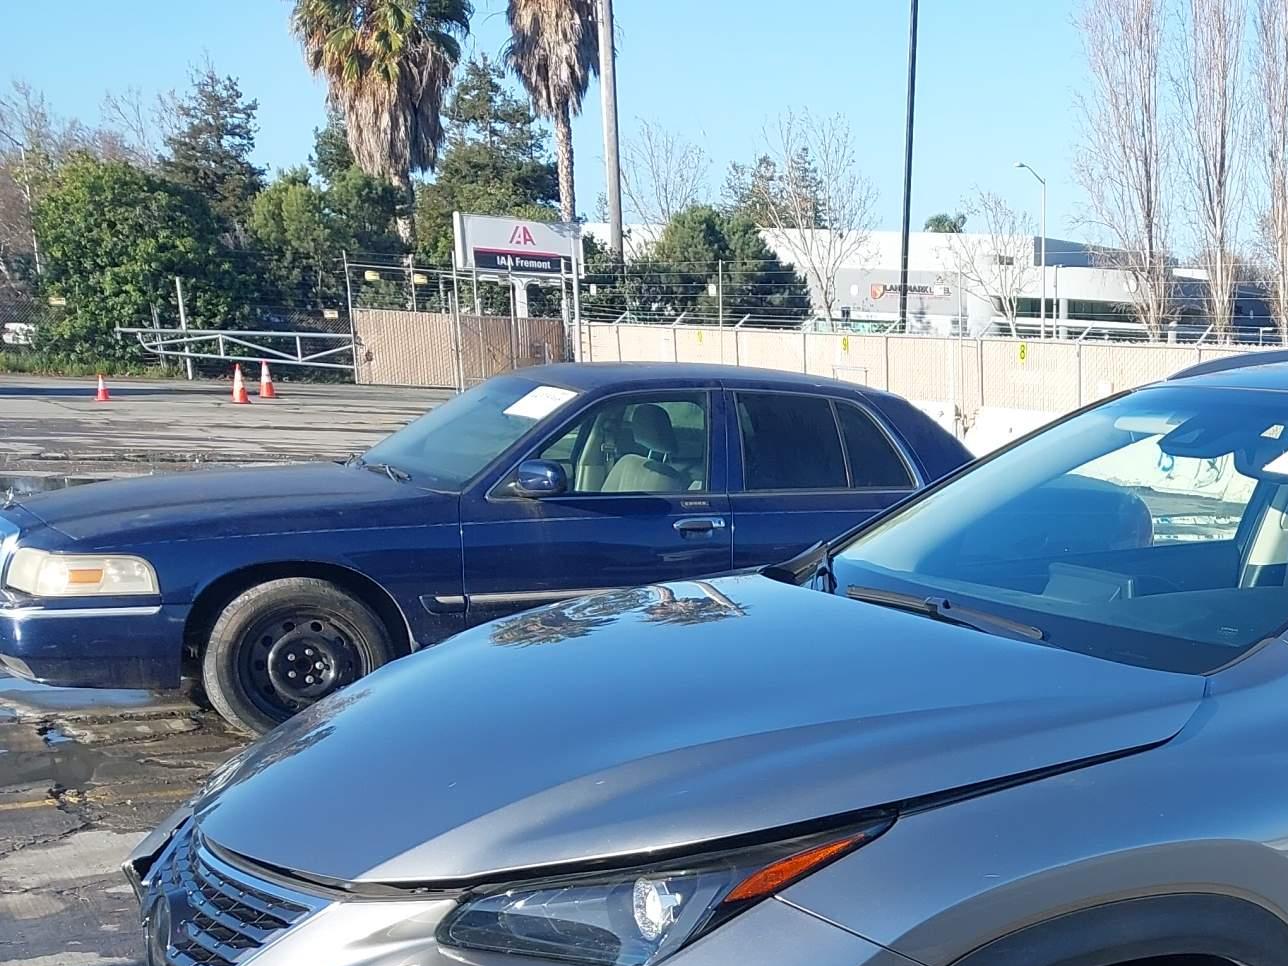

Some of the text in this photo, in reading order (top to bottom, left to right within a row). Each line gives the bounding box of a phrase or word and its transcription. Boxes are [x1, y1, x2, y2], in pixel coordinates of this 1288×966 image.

[496, 255, 551, 270] IAA Fremont
[884, 284, 929, 294] LANMARK
[1019, 344, 1026, 360] 8
